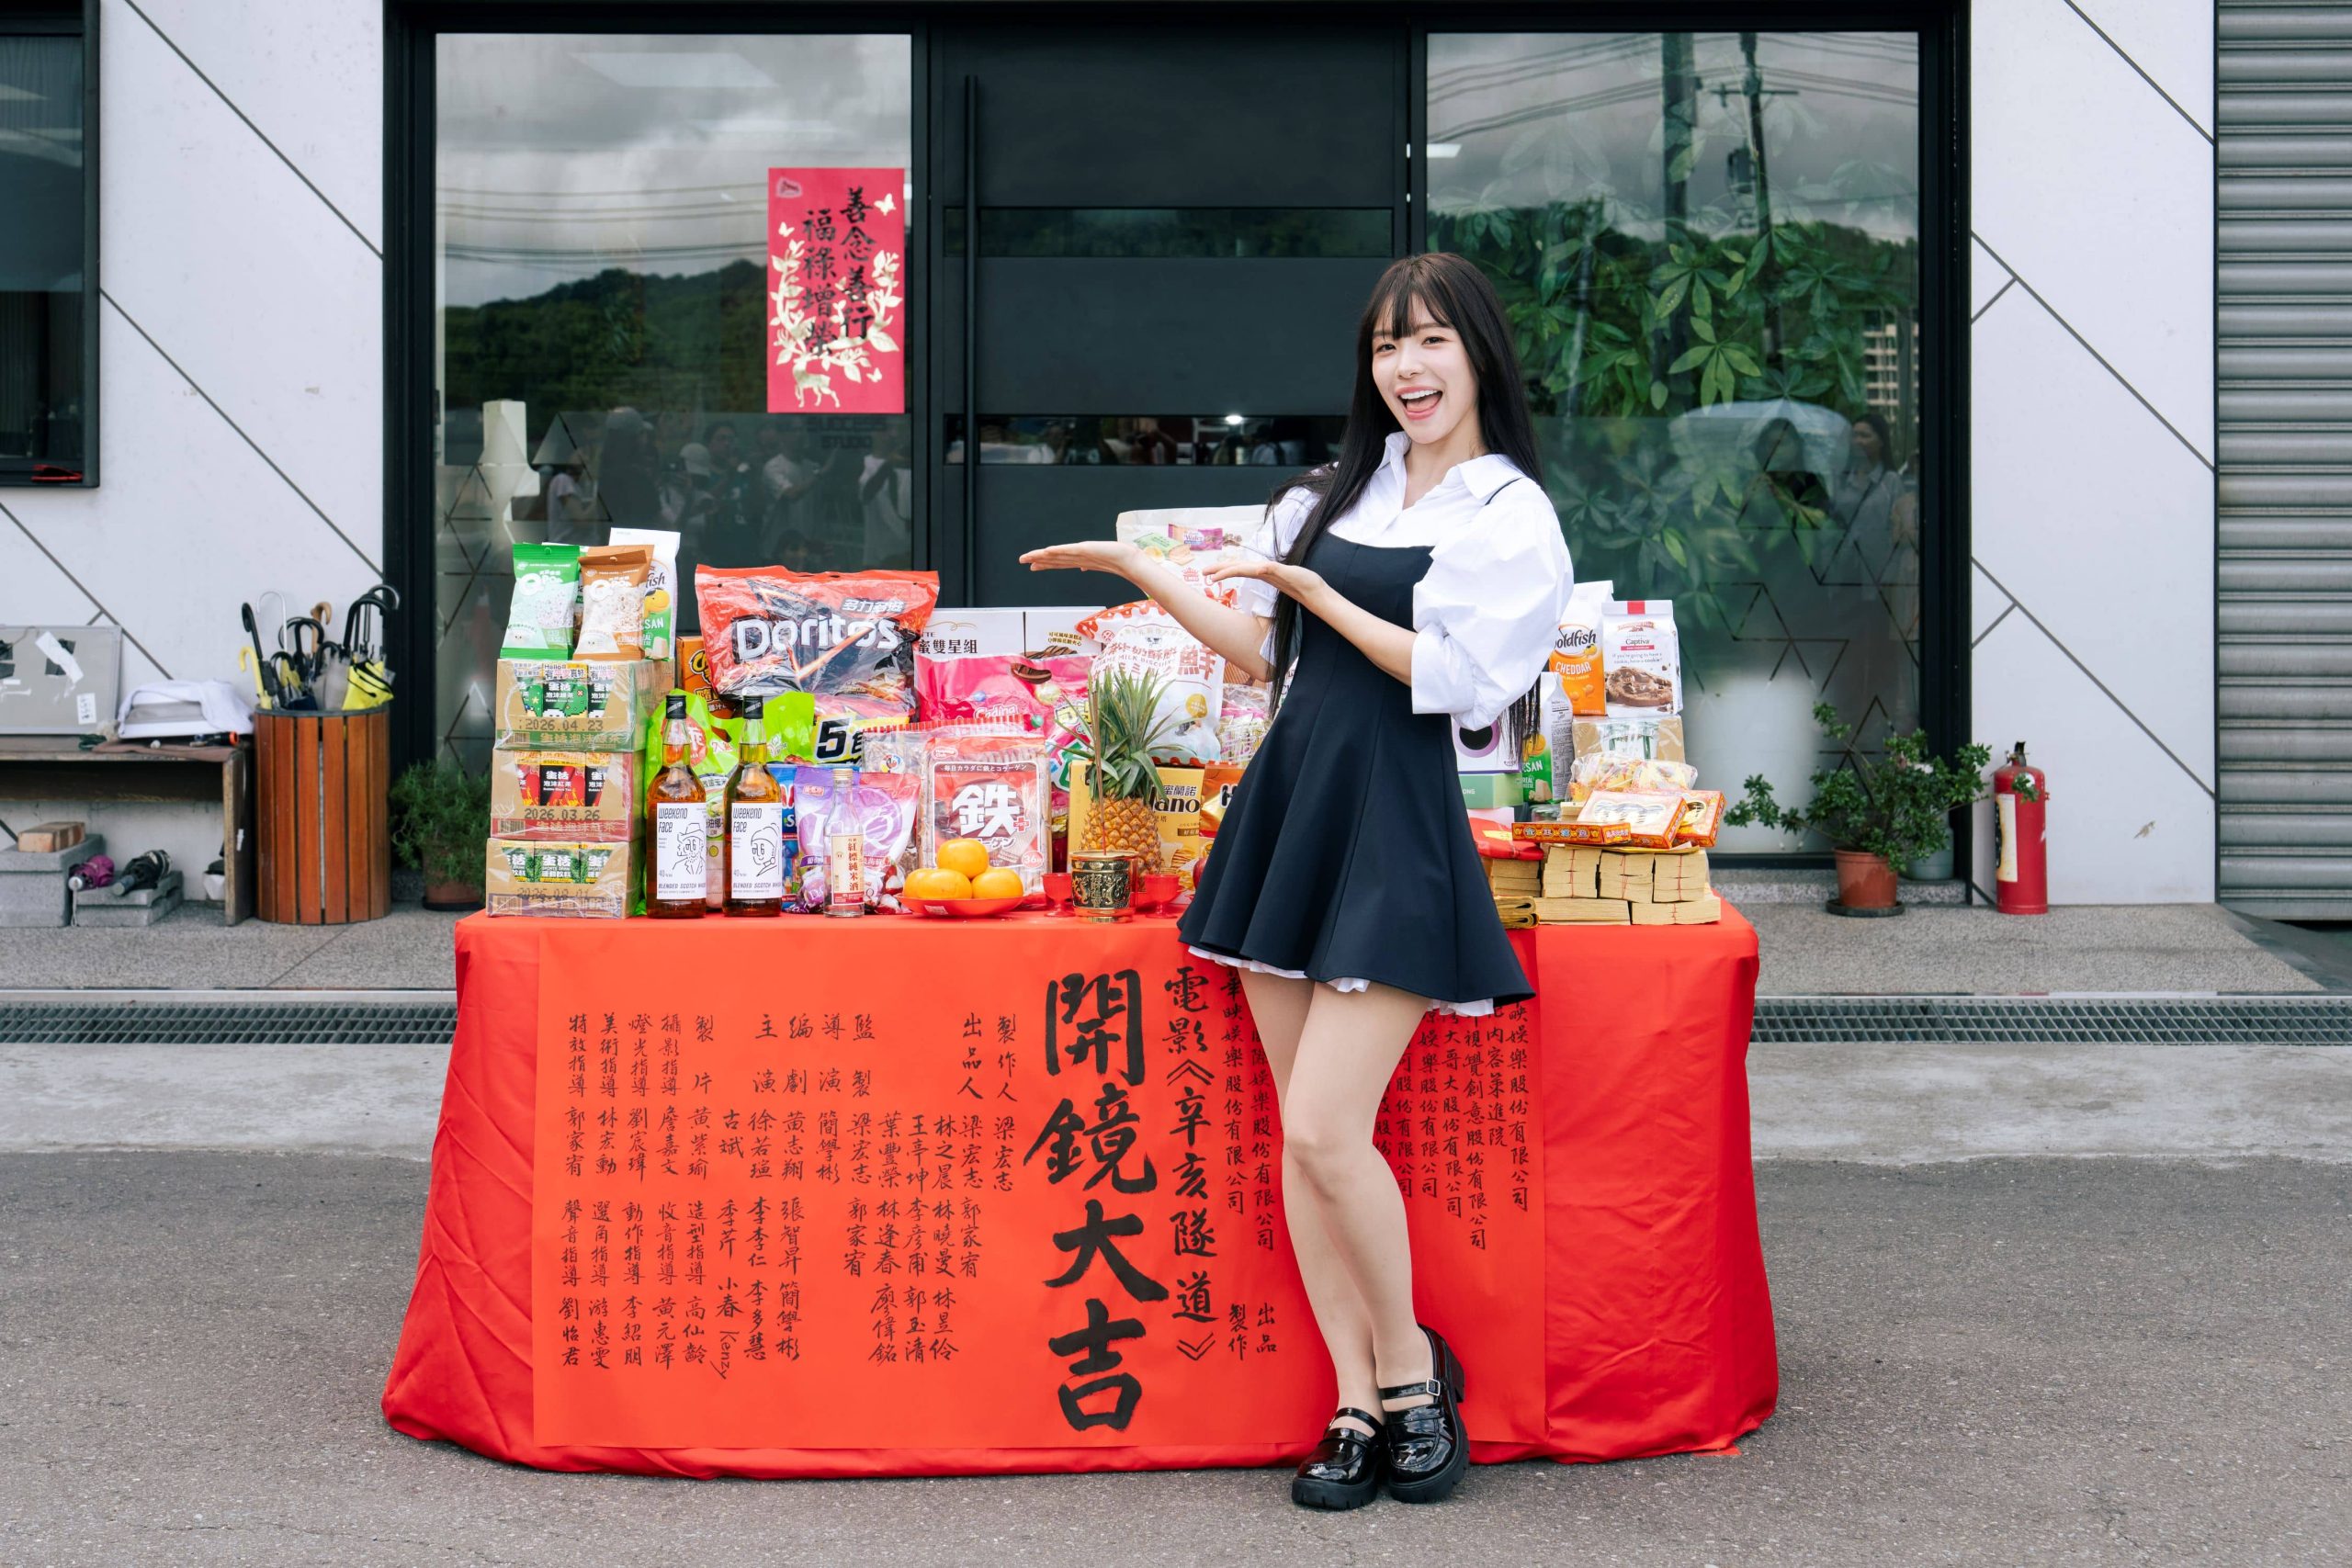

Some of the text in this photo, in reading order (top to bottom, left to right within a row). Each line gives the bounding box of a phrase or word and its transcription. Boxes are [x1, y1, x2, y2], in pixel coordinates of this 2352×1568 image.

[840, 186, 876, 340] 善念善行
[646, 573, 666, 588] fish
[842, 599, 903, 613] 多力多滋
[644, 617, 664, 629] SAN
[736, 615, 899, 659] Doritos
[919, 639, 978, 654] 蜜雙星組
[1555, 629, 1597, 649] oldfish
[1555, 661, 1591, 675] CHEDDAR
[525, 808, 601, 820] 2026.03.26
[952, 784, 1021, 838] 鉄
[847, 841, 860, 891] 紅標純米酒
[569, 1014, 586, 1097] 特效指導
[601, 1012, 617, 1098] 美術指導
[631, 1014, 651, 1097] 燈光指導
[662, 1014, 679, 1095] 攝影指導
[695, 1016, 713, 1093] 製片
[820, 1013, 844, 1091] 導演
[719, 1110, 743, 1158] 古斌
[749, 1014, 777, 1178] 主演 徐若瑄
[782, 1016, 813, 1180] 編劇 黃志翔
[852, 1014, 875, 1184] 監製 梁宏志
[957, 1012, 983, 1189] 出品人 梁宏志
[994, 1014, 1017, 1191] 製作人 梁宏志
[933, 1115, 956, 1190] 林之晨
[1023, 969, 1170, 1431] 開鏡大吉
[559, 1200, 582, 1366] 聲音指導 劉怡君
[591, 1201, 611, 1287] 選角指導
[622, 1202, 643, 1366] 動作指導 李紹朋
[658, 1202, 678, 1285] 收音指導
[683, 1201, 707, 1364] 造型指導 高仙齡
[744, 1196, 770, 1360] 李李仁 李多慧
[868, 1200, 901, 1367] 林逢春 廖偉銘
[713, 1200, 742, 1379] 季芹 小春 Kenzy
[1257, 1303, 1277, 1353] 出品
[1228, 1303, 1249, 1360] 製作
